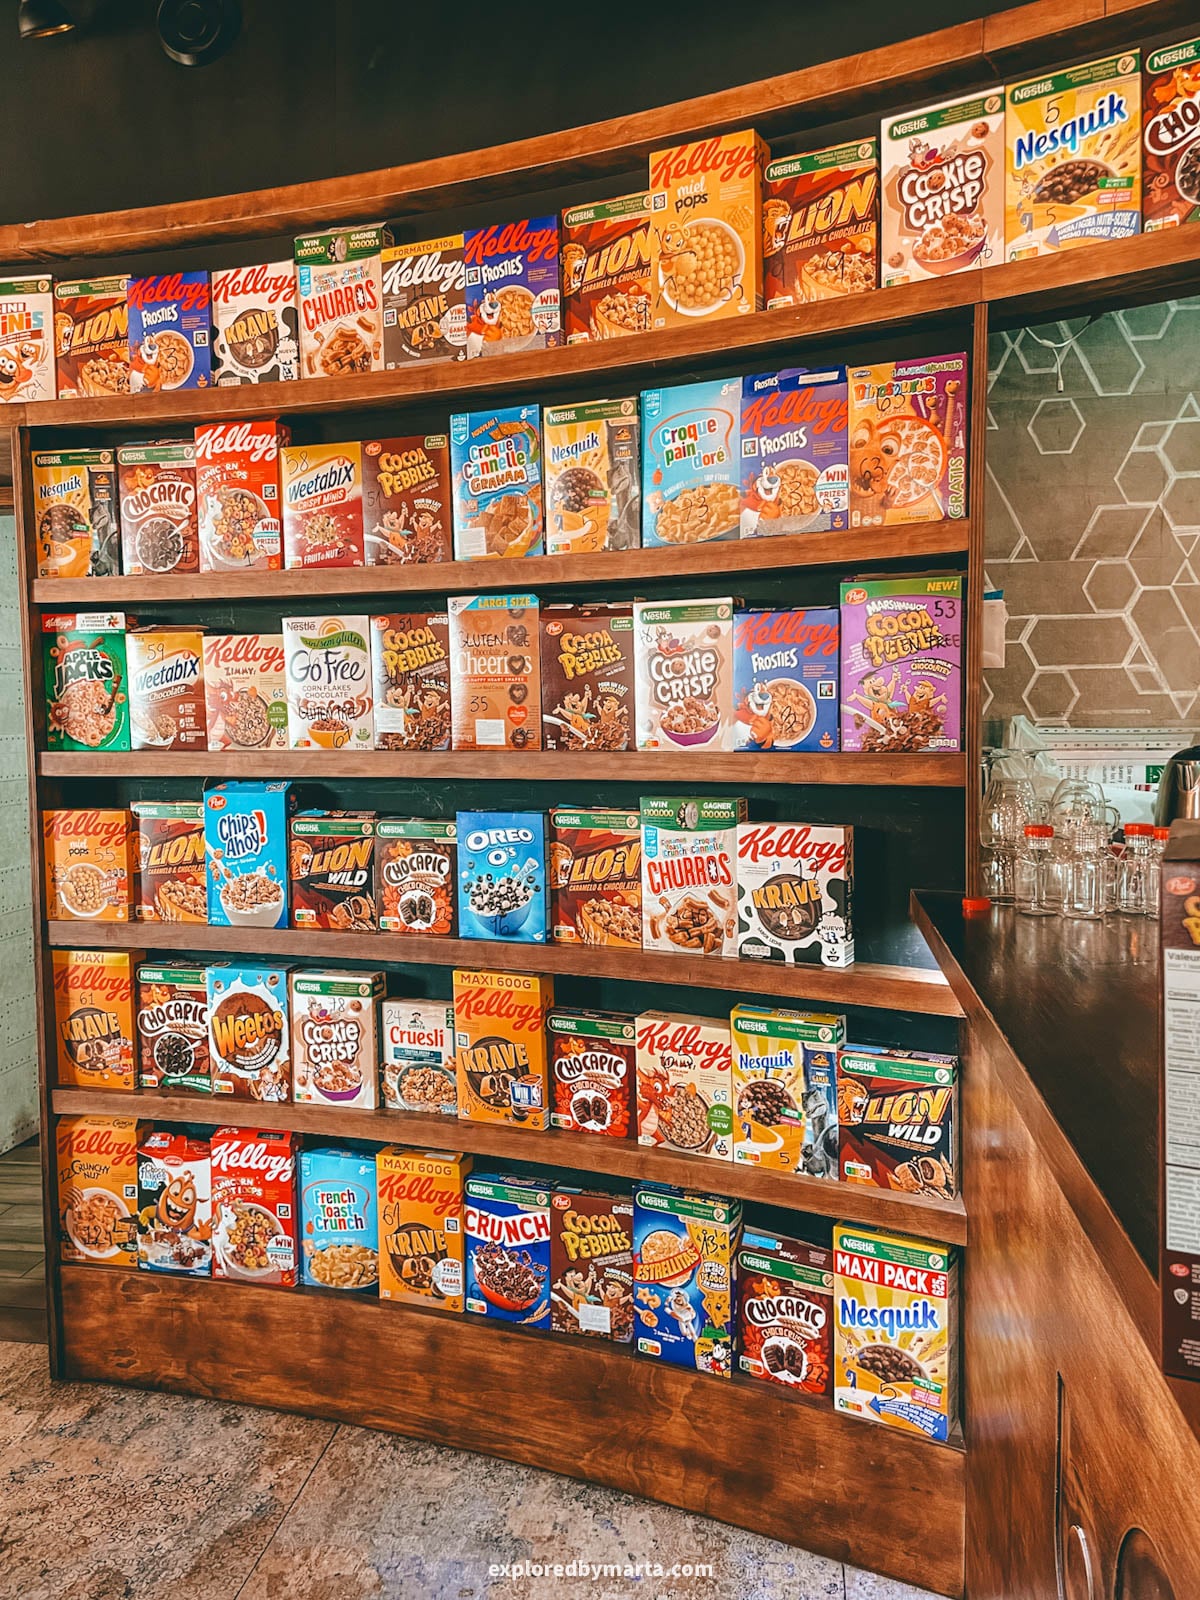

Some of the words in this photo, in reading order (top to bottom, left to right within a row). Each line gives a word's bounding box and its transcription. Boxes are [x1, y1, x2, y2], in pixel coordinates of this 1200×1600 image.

[1153, 45, 1198, 68] Nestlé
[1014, 80, 1054, 102] Nestlé
[1045, 96, 1064, 124] 5
[892, 118, 928, 137] Nestlé
[1015, 92, 1127, 168] Nesquik
[769, 162, 802, 178] Nestlé
[901, 155, 982, 205] Cookie
[677, 176, 706, 199] miel
[675, 192, 708, 213] pops
[788, 174, 878, 241] LION
[303, 240, 320, 248] WIN
[350, 231, 377, 241] GAGNER
[786, 237, 820, 253] CARAMELO
[829, 222, 872, 242] CHOCOLATE
[393, 244, 431, 257] FORMATO
[481, 255, 523, 285] FROSTIES
[302, 279, 377, 331] CHURROS
[540, 294, 558, 304] WIN
[141, 303, 178, 329] FROSTIES
[399, 294, 449, 329] KRAVE
[224, 309, 278, 345] KRAVE
[660, 418, 717, 445] Croque
[760, 426, 808, 455] FROSTIES
[378, 447, 428, 472] COCOA
[470, 440, 513, 461] Croque
[551, 432, 599, 463] Nesquik
[665, 441, 696, 466] pain
[692, 446, 726, 470] doré
[286, 450, 309, 476] 58
[463, 451, 525, 479] Cannelle
[39, 475, 82, 499] Nesquik
[288, 463, 355, 503] Weetabix
[377, 462, 436, 498] PEBBLES
[470, 468, 525, 492] GRAHAM
[825, 470, 847, 483] WIN
[948, 456, 965, 519] GRATIS
[123, 483, 193, 522] CHOCAPIC
[261, 521, 279, 531] WIN
[927, 581, 958, 592] NEW!
[478, 598, 507, 608] LARGE
[511, 597, 530, 607] SIZE
[934, 600, 956, 619] 53
[866, 610, 934, 638] COCOA
[383, 626, 436, 651] COCOA
[560, 629, 613, 655] COCOA
[65, 650, 100, 664] APPLE
[147, 643, 165, 661] 59
[382, 642, 446, 678] PEBBLES
[752, 648, 798, 674] FROSTIES
[135, 656, 200, 692] Weetabix
[321, 651, 366, 684] Free
[651, 651, 715, 682] Cookie
[54, 660, 113, 698] JACKS
[149, 685, 186, 700] Chocolate
[219, 814, 256, 841] Chips
[69, 848, 89, 856] pops
[466, 828, 533, 852] OREO
[94, 846, 115, 863] 55
[311, 839, 373, 874] LION
[570, 842, 640, 882] LION
[327, 870, 368, 887] WILD
[384, 854, 448, 885] CHOCAPIC
[647, 852, 733, 896] CHURROS
[398, 881, 415, 895] CHOCO
[415, 882, 435, 896] CRUSH
[569, 884, 596, 892] CARAMELO
[603, 882, 638, 892] CHOCOLATE
[752, 880, 822, 909] KRAVE
[75, 953, 104, 963] MAXI
[460, 974, 494, 986] MAXI
[497, 978, 532, 989] 600G
[79, 992, 96, 1006] 61
[61, 1012, 120, 1041] KRAVE
[212, 1010, 283, 1057] Weetos
[303, 1020, 358, 1044] Cookie
[390, 1025, 444, 1047] Cruesli
[737, 1019, 768, 1033] Nestlé
[462, 1044, 528, 1073] KRAVE
[556, 1053, 624, 1082] CHOCAPIC
[740, 1051, 794, 1070] Nesquik
[844, 1058, 877, 1072] Nestlé
[570, 1081, 589, 1093] CHOCO
[589, 1081, 611, 1099] CRUSH
[714, 1089, 728, 1101] 65
[864, 1087, 952, 1125] LION
[888, 1123, 942, 1145] WILD
[71, 1159, 110, 1175] CRUNCHY
[383, 1158, 415, 1171] MAXI
[418, 1162, 453, 1176] 600G
[779, 1152, 790, 1164] 5
[84, 1172, 100, 1180] NUT
[314, 1188, 356, 1203] French
[315, 1213, 364, 1232] Crunch
[320, 1204, 353, 1218] Toast
[382, 1201, 401, 1228] 61
[563, 1210, 622, 1235] COCOA
[464, 1209, 550, 1244] CRUNCH
[275, 1237, 292, 1247] WIN
[386, 1229, 447, 1257] KRAVE
[560, 1230, 632, 1262] PEBBLES
[843, 1238, 876, 1254] Nestlé
[635, 1247, 700, 1282] ESTRELLITAS
[836, 1252, 879, 1283] MAXI
[884, 1264, 929, 1294] PACK
[932, 1275, 947, 1297] 625g
[746, 1300, 824, 1330] CHOCAPIC
[840, 1298, 938, 1337] Nesquik
[762, 1328, 784, 1340] CHOCO
[783, 1331, 807, 1349] CRUSH
